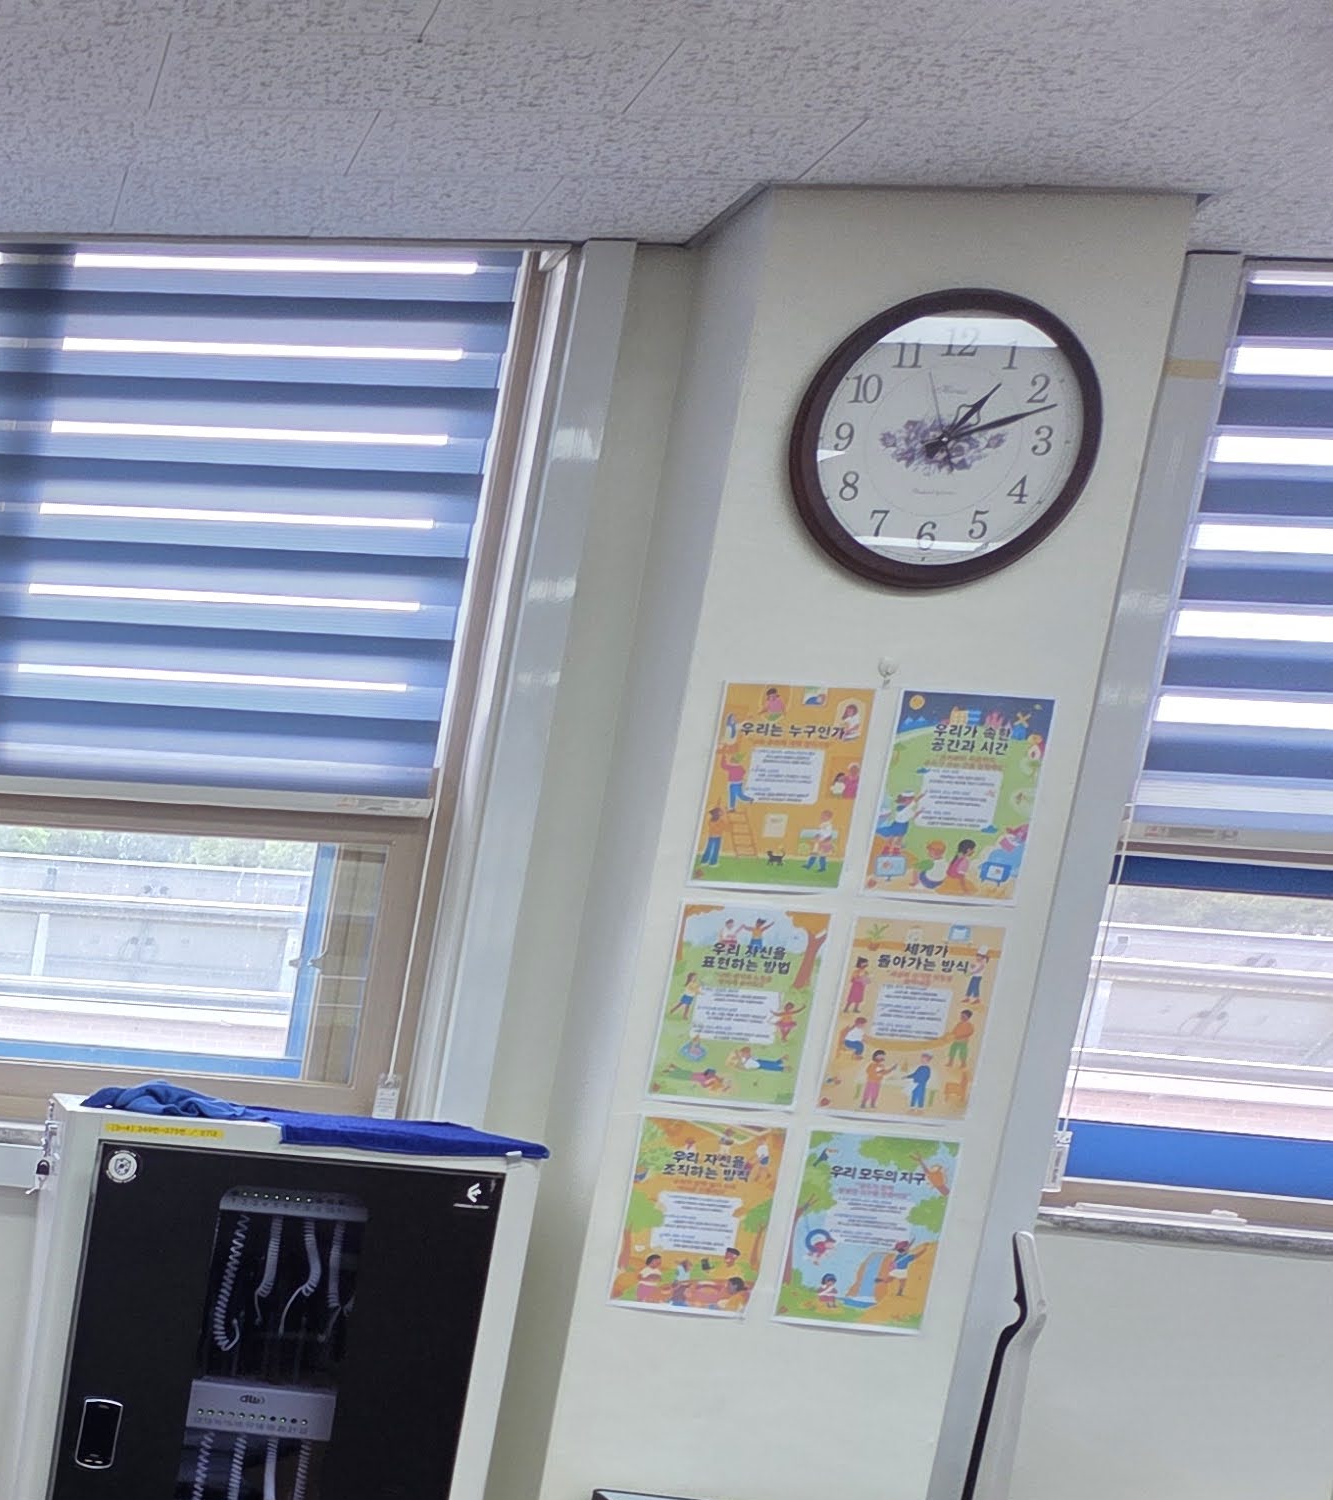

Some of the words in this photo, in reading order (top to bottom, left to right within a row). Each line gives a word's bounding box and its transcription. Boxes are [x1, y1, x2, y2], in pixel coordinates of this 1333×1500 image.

[892, 342, 923, 369] 11
[940, 327, 981, 357] 12
[1002, 340, 1018, 370] 1
[847, 373, 883, 404] 10
[1026, 373, 1051, 404] 2
[833, 422, 855, 452] 9
[1031, 425, 1054, 456] 3
[838, 470, 860, 501] 8
[1007, 474, 1029, 505] 4
[869, 509, 890, 537] 7
[916, 520, 936, 551] 6
[968, 509, 989, 540] 5
[740, 722, 784, 738] 우리는
[788, 724, 846, 740] 누구인가
[933, 723, 978, 739] 우리가
[931, 737, 975, 753] 공간과
[980, 740, 1009, 756] 시간
[712, 942, 741, 957] 우리
[744, 944, 787, 961] 자신을
[904, 943, 949, 958] 세계가
[701, 955, 758, 973] 표현하는
[763, 960, 791, 976] 방법
[940, 959, 970, 974] 방식
[662, 1163, 719, 1180] 조직하는
[672, 1150, 700, 1164] 우리
[703, 1153, 745, 1169] 자신을
[829, 1165, 857, 1180] 우리
[858, 1167, 898, 1183] 모두의
[899, 1171, 926, 1186] 지구
